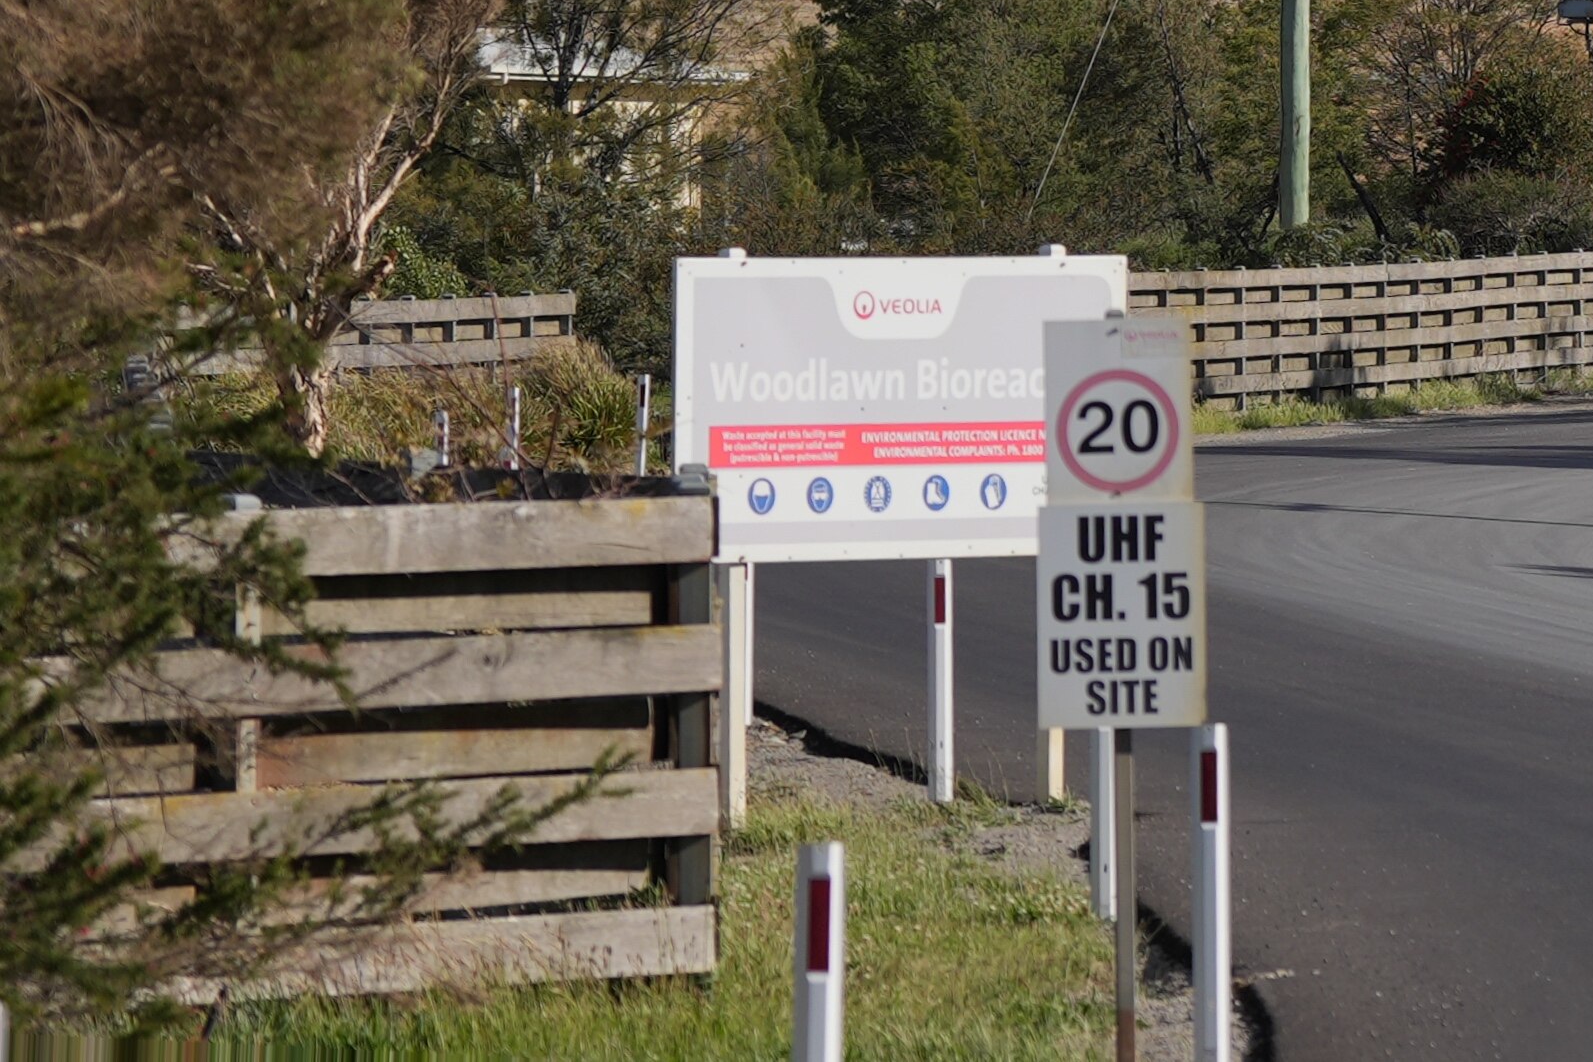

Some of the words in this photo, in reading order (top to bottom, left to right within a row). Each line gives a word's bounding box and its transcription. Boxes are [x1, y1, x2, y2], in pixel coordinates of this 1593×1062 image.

[880, 298, 942, 314] VEOLIA
[709, 357, 905, 403] Woodlawn
[861, 430, 940, 444] ENVIRONMENTAL
[942, 429, 998, 443] PROTECTION
[1000, 429, 1037, 441] LICENCE
[1077, 399, 1159, 454] 20
[874, 445, 947, 459] ENVIRONMENTAL
[1022, 444, 1044, 456] 1800
[1077, 514, 1164, 563] UHF
[1052, 573, 1126, 623] CH.
[1138, 572, 1190, 620] 15
[1051, 638, 1137, 674] USED
[1149, 637, 1193, 671] ON
[1086, 679, 1159, 715] SITE
